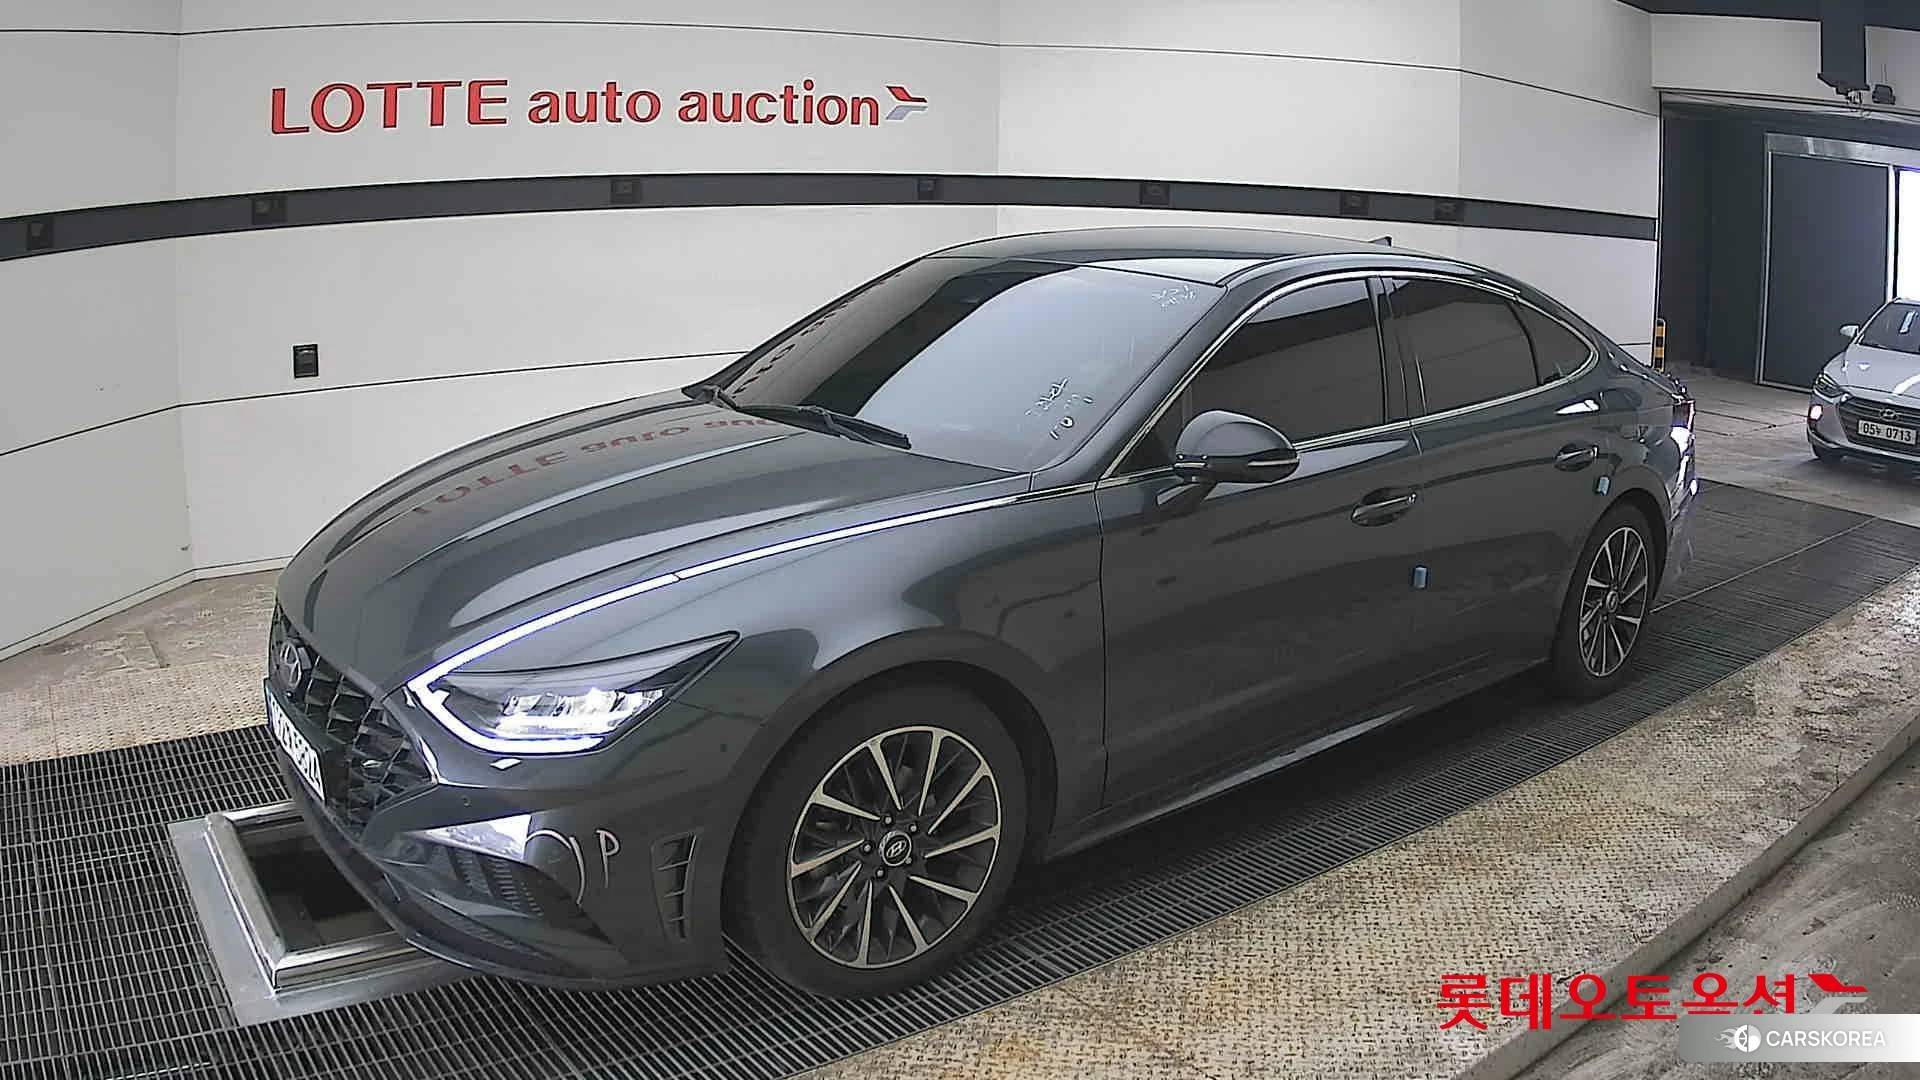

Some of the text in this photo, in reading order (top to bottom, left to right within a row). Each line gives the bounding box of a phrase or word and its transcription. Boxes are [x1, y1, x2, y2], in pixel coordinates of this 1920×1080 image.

[271, 79, 879, 134] LOTTE auto auction
[1886, 427, 1912, 442] 0713
